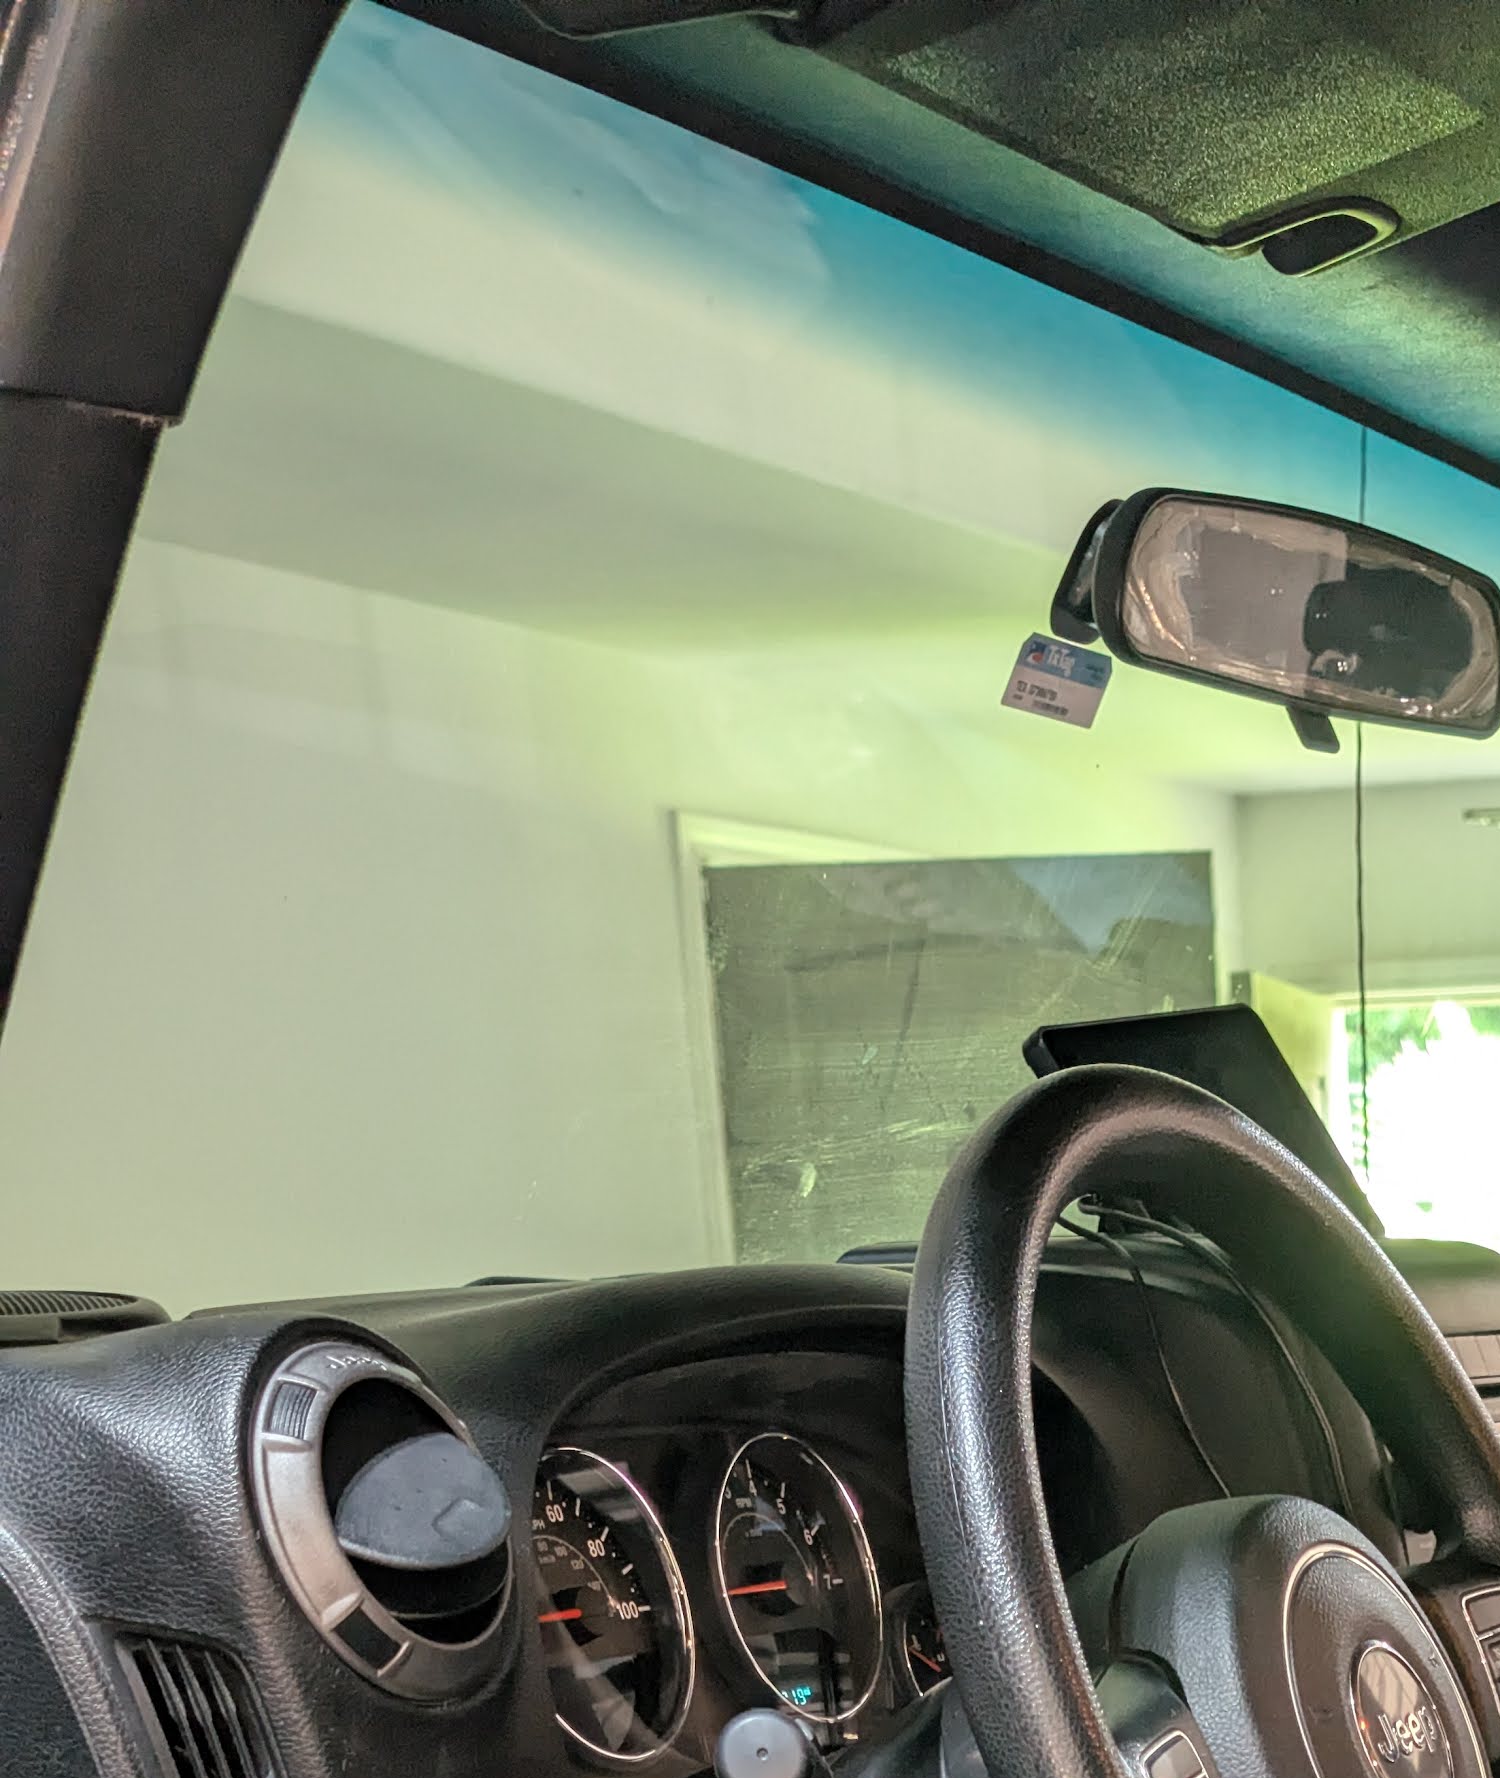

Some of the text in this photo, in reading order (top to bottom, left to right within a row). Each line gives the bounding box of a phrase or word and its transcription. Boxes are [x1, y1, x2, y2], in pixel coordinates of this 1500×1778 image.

[545, 1503, 565, 1523] 60
[776, 1498, 787, 1515] 5
[803, 1528, 813, 1546] 6
[586, 1538, 606, 1558] 80
[823, 1573, 832, 1590] 7
[616, 1600, 640, 1621] 100
[1376, 1706, 1436, 1763] Jeep
